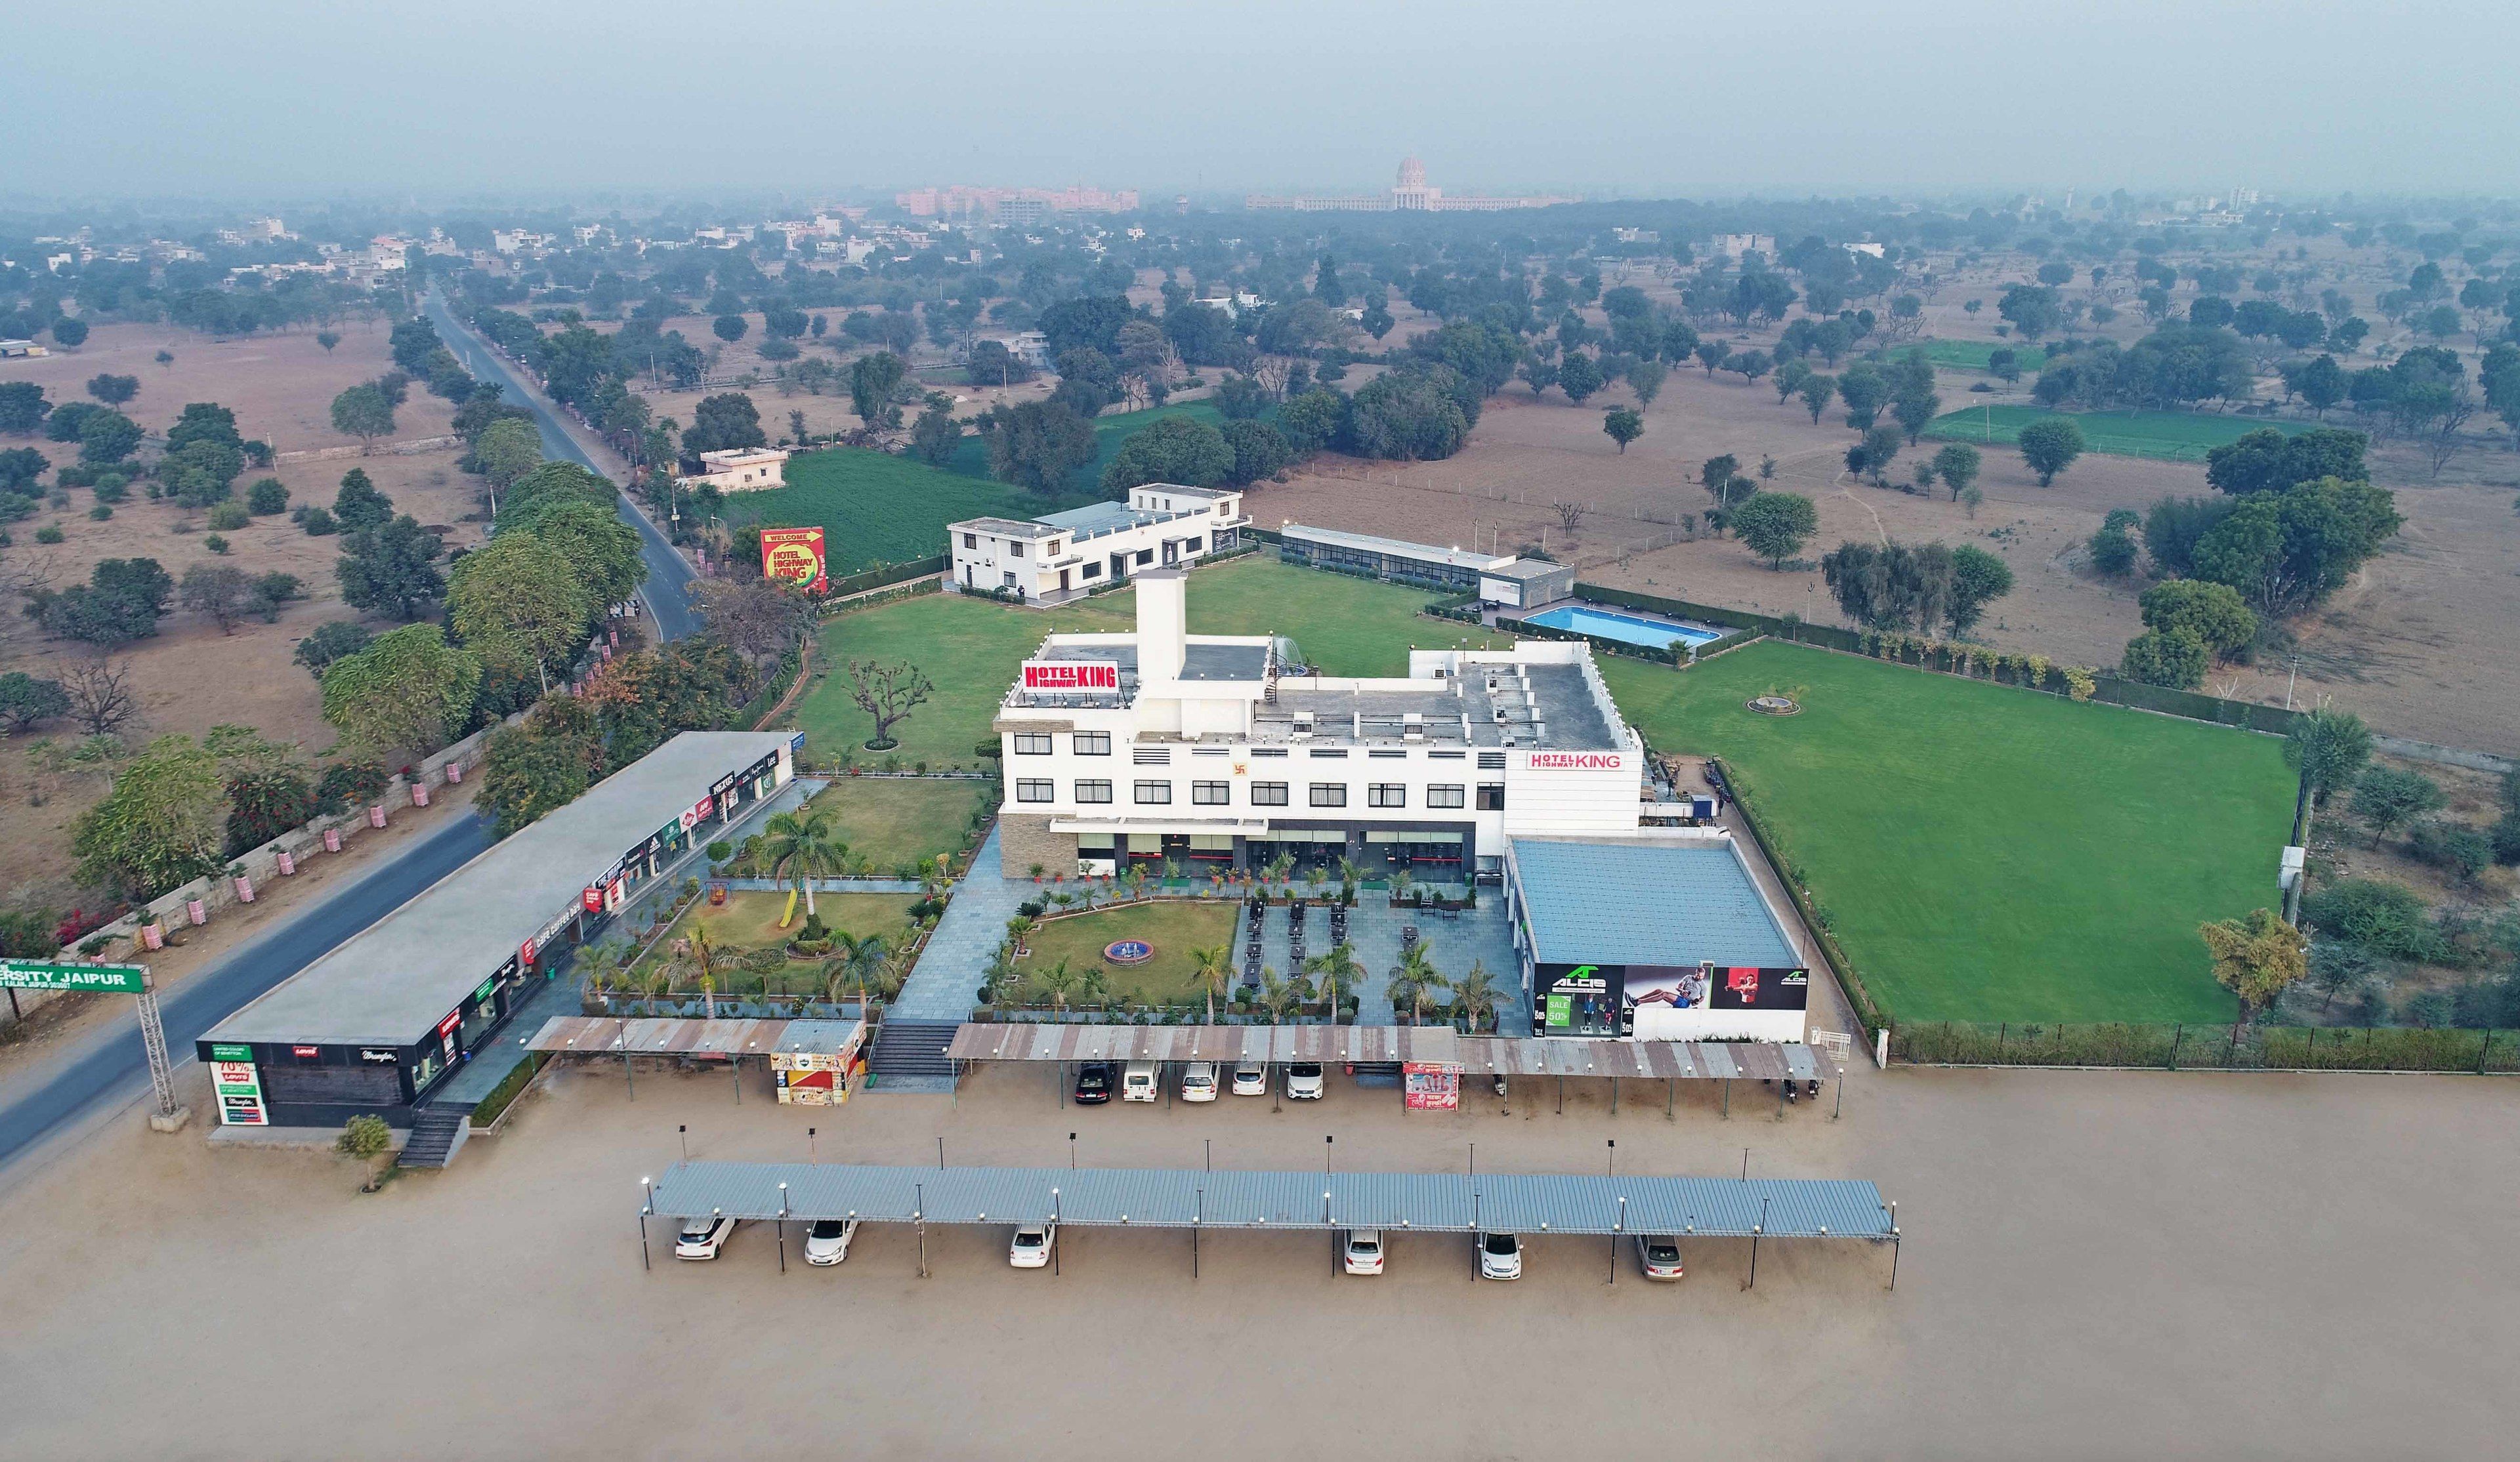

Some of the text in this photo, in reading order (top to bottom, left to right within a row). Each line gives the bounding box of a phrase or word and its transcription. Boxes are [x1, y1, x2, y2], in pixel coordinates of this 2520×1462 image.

[774, 558, 813, 568] HIGHWAY
[774, 567, 807, 579] KING
[1025, 667, 1116, 688] HOTEL KING
[767, 755, 776, 767] Lee
[1532, 755, 1620, 768] HOTEL KING
[713, 775, 734, 795] NEXUS
[60, 972, 127, 985] JAIPUR
